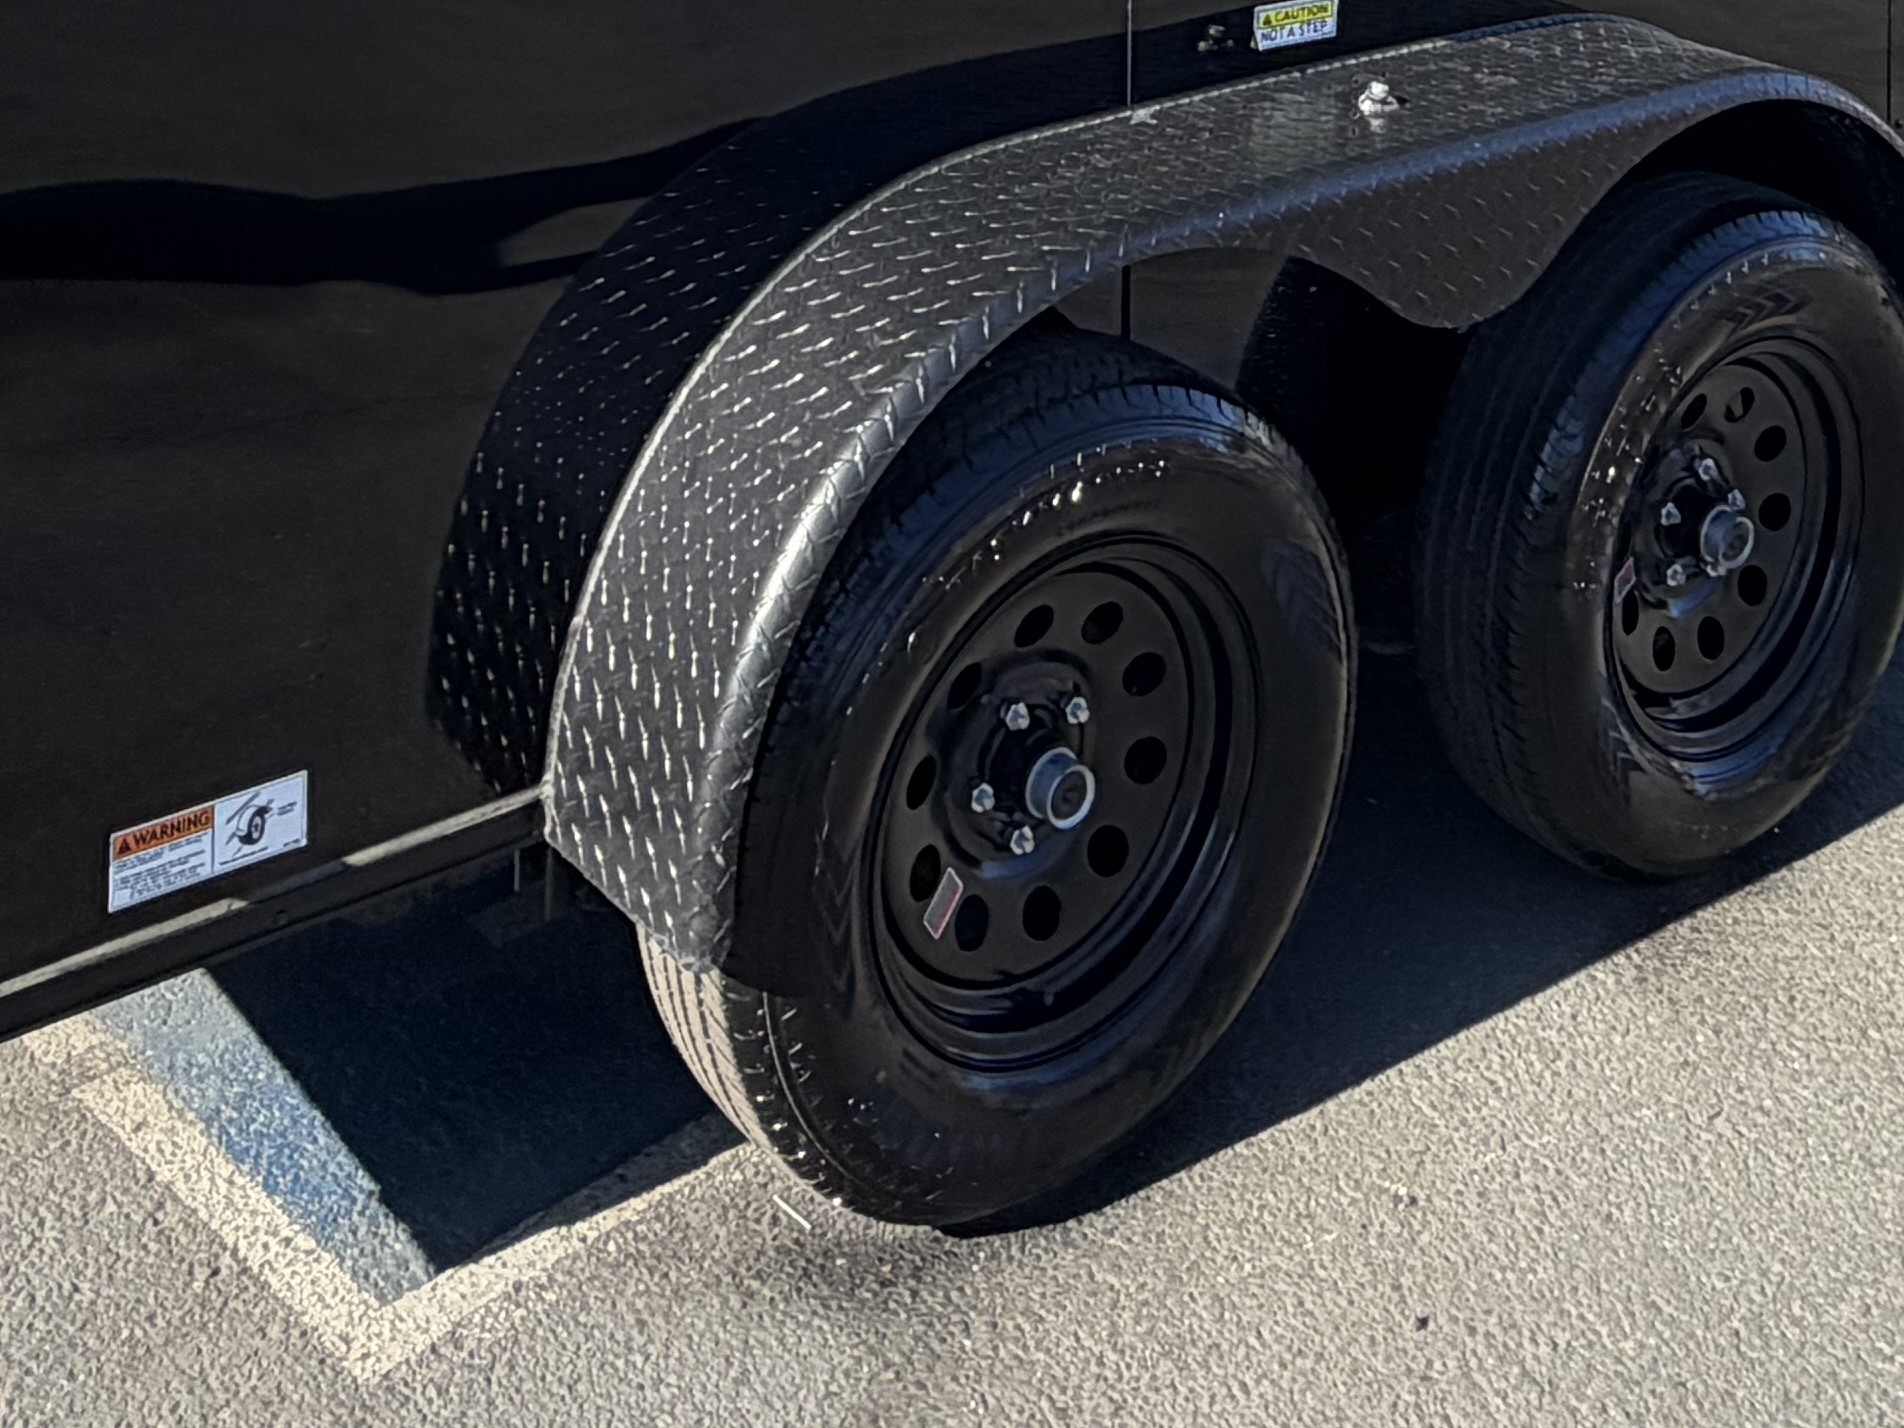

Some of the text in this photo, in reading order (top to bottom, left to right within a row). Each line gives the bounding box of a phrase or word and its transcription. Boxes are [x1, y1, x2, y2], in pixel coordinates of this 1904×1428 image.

[1274, 4, 1328, 22] CAUTION
[1260, 20, 1328, 43] NOT A STEP
[134, 810, 212, 846] WARNING
